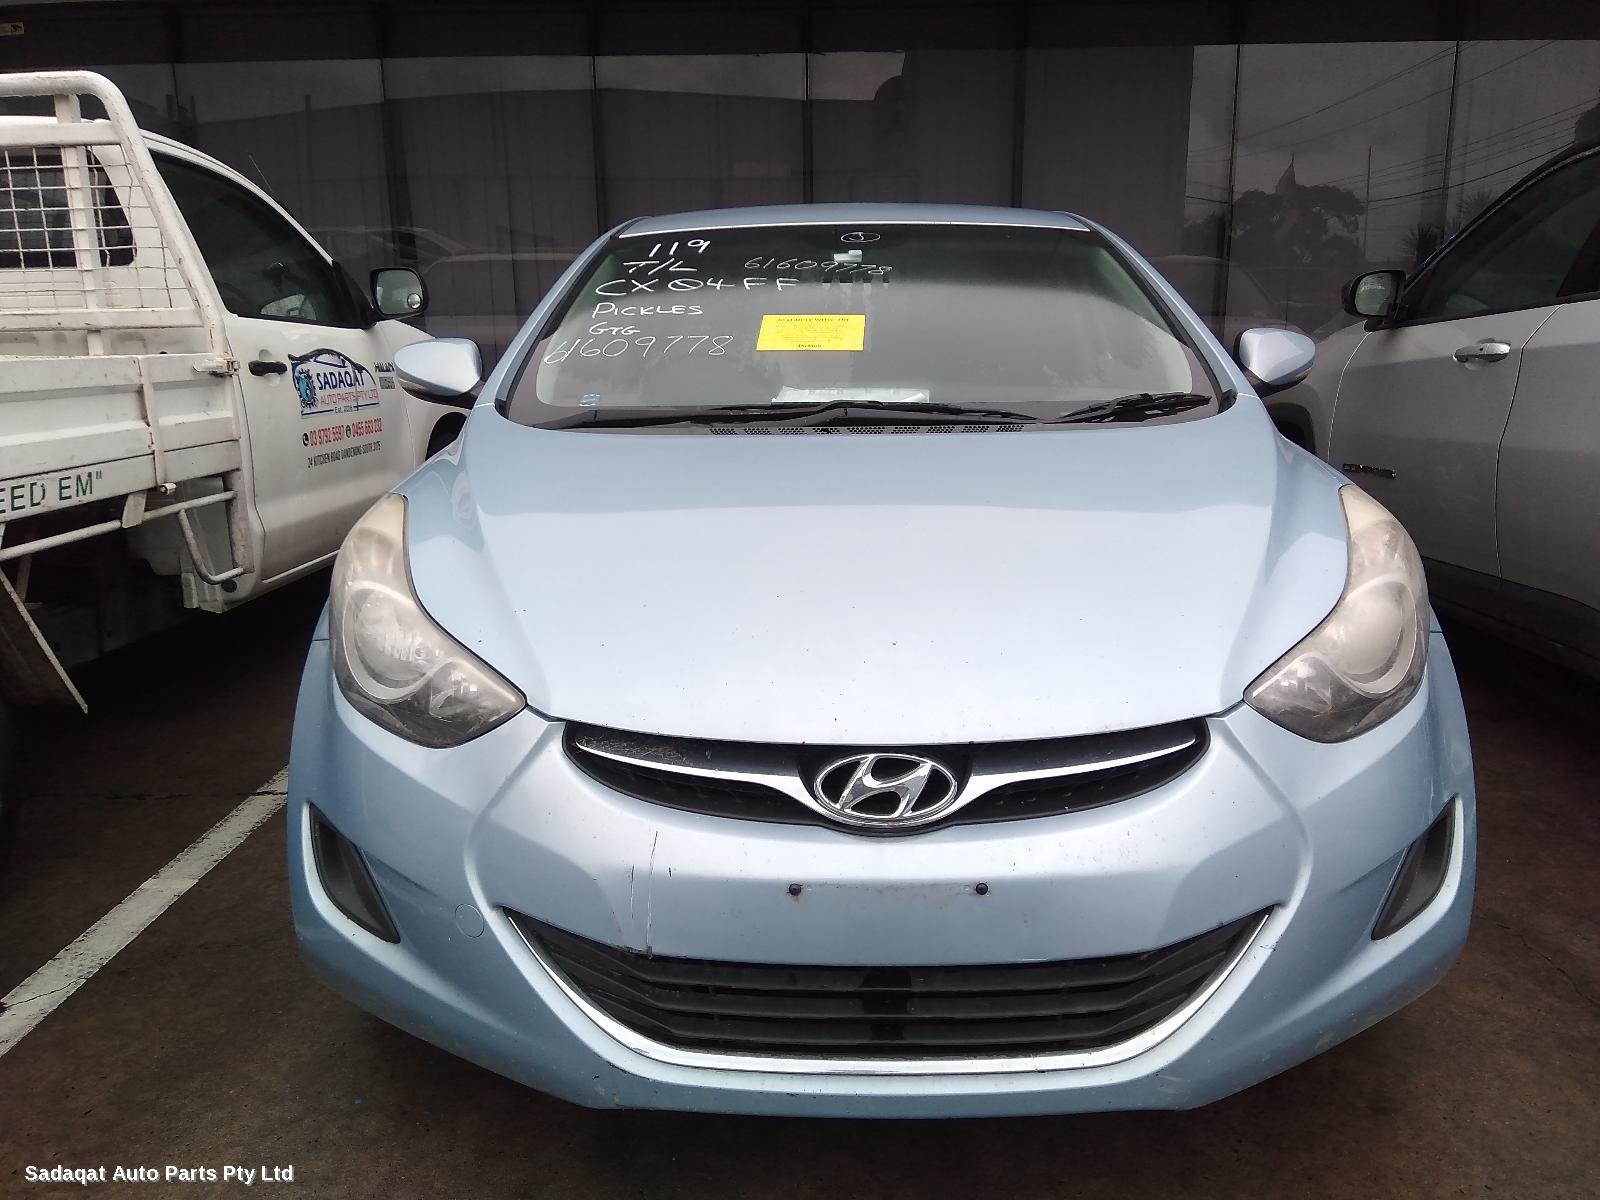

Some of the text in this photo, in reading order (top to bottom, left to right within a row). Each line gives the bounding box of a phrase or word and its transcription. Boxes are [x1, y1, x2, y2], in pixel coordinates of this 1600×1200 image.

[649, 239, 710, 257] 119
[623, 258, 698, 275] T/L
[592, 303, 704, 319] PICKLES
[543, 335, 735, 364] 61609778
[316, 370, 365, 391] SADAQAT
[320, 387, 379, 406] AUTO PARTS PTY LTD
[309, 430, 318, 447] 03
[318, 427, 332, 445] 9792
[352, 421, 365, 438] 0455
[330, 450, 341, 462] ROAD
